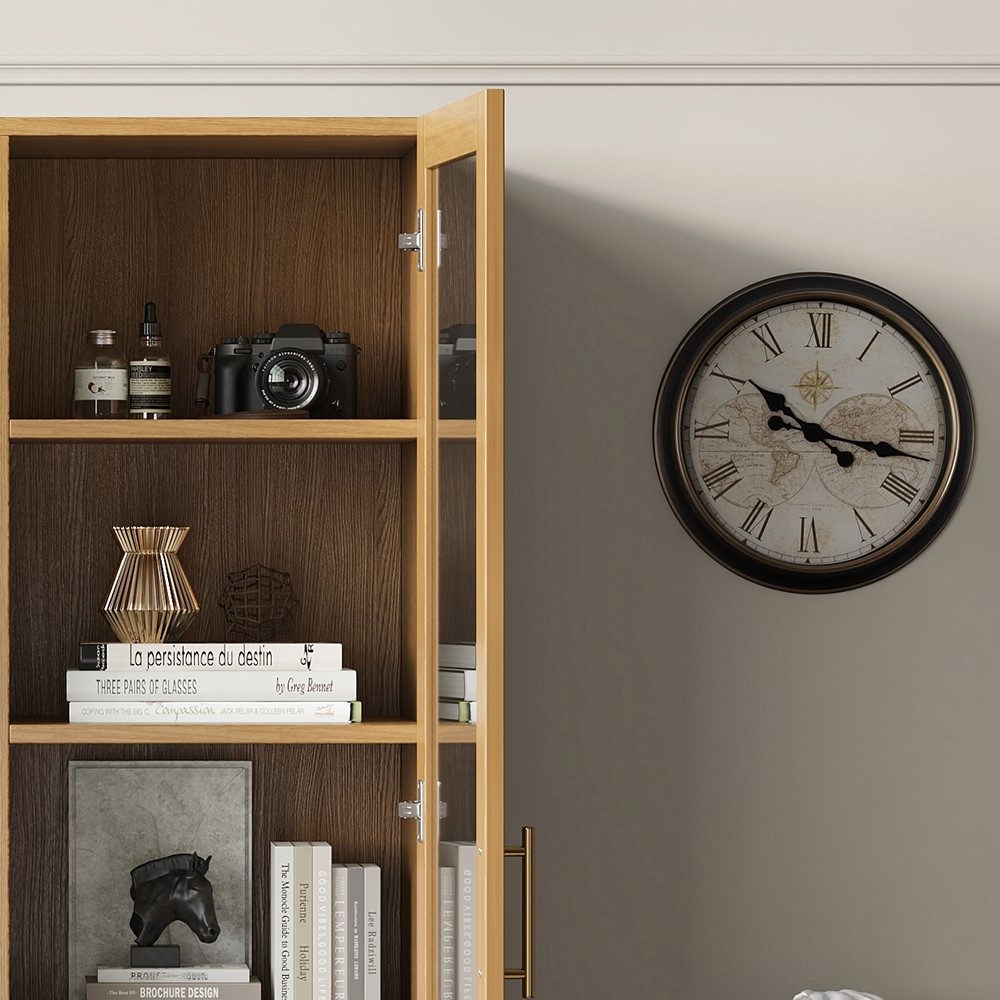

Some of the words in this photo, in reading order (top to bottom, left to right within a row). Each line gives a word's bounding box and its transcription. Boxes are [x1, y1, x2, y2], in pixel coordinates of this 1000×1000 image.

[129, 643, 143, 667] La
[147, 644, 215, 672] persistance
[218, 643, 233, 667] du
[238, 644, 273, 667] destin
[96, 679, 121, 694] THREE
[124, 679, 147, 694] PAIRS
[149, 679, 160, 694] OF
[162, 679, 198, 694] GLASSES
[275, 677, 285, 695] by
[287, 677, 306, 695] Greg
[307, 677, 334, 693] Bennet
[120, 707, 132, 716] THE
[155, 702, 216, 722] Compassion
[281, 862, 290, 879] The
[281, 880, 290, 914] Monocle
[318, 870, 327, 902] GOOD
[300, 883, 309, 924] Purienne
[281, 915, 290, 939] Guide
[368, 911, 377, 928] Lee
[281, 940, 289, 951] to
[334, 900, 345, 1000] LEMPEREUR
[368, 931, 377, 975] Radziwill
[281, 950, 290, 972] Good
[297, 945, 309, 982] Holiday
[139, 987, 186, 999] BROCHURE
[188, 987, 219, 999] DESIGN
[318, 977, 327, 1000] LIFE
